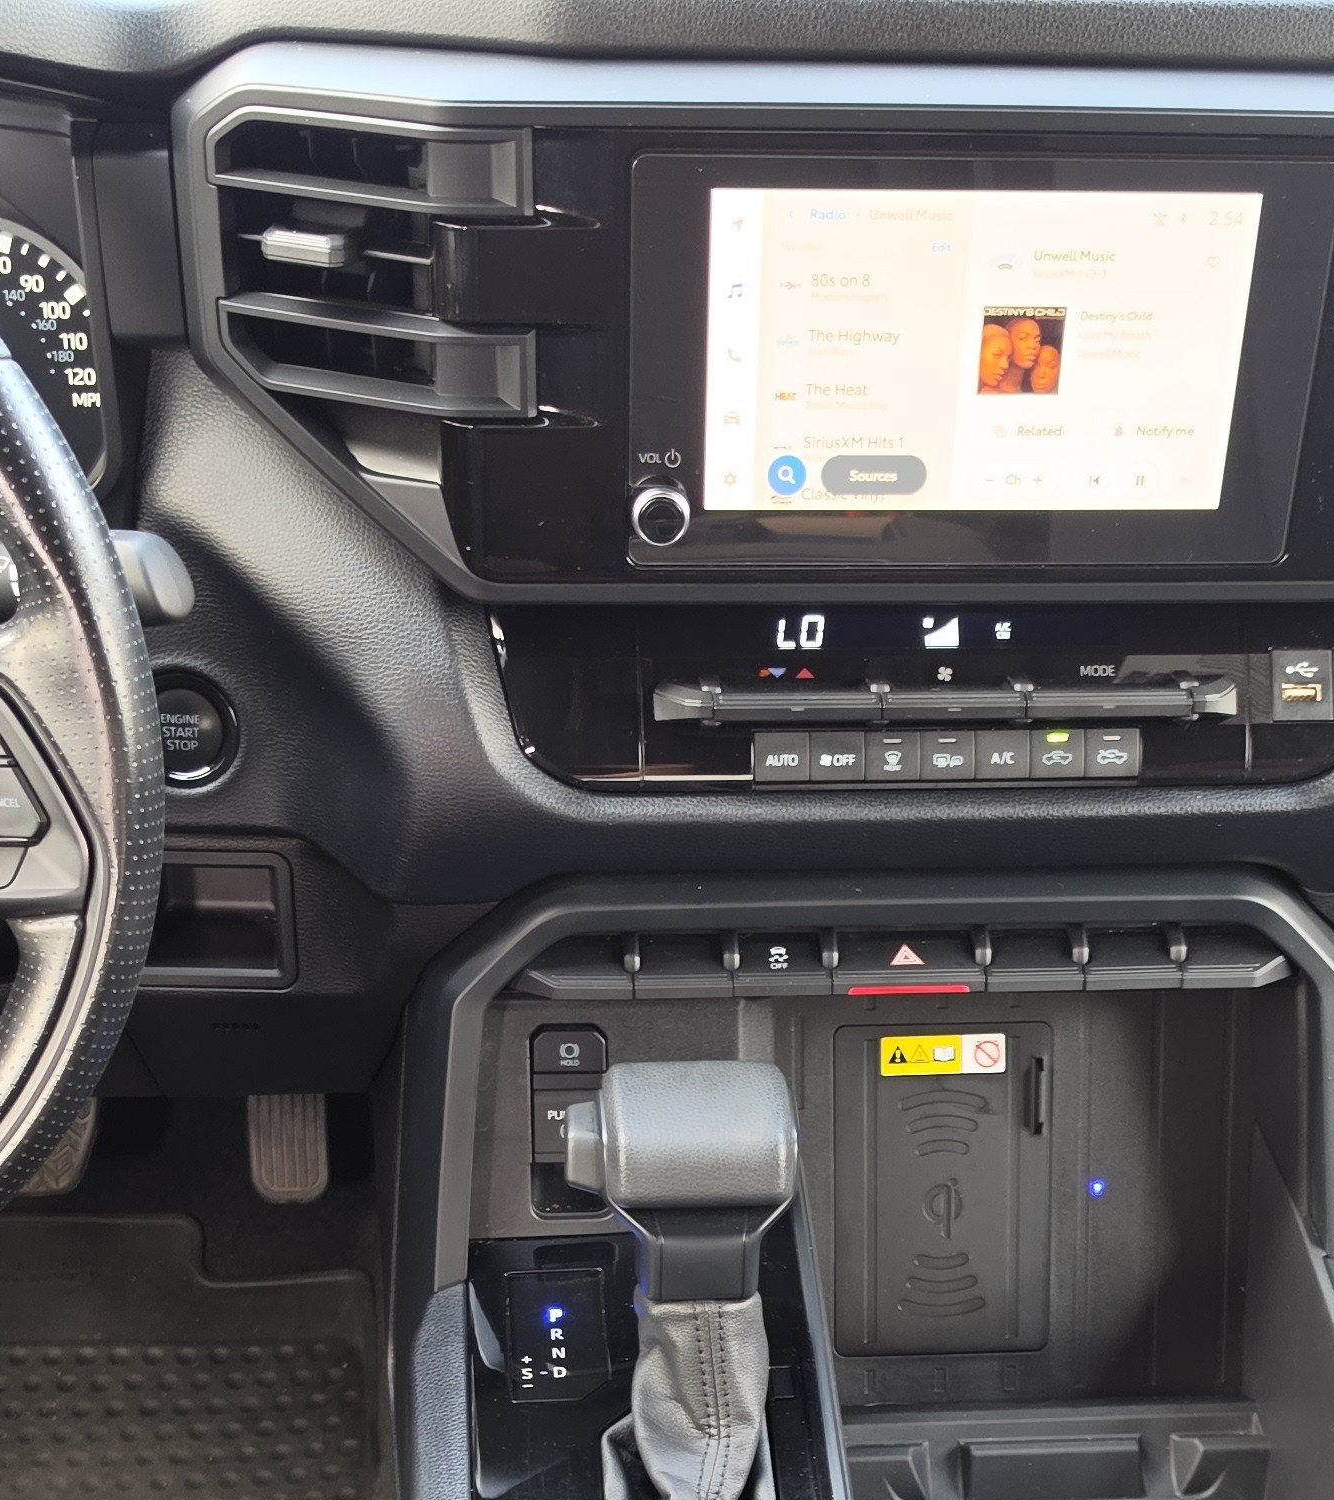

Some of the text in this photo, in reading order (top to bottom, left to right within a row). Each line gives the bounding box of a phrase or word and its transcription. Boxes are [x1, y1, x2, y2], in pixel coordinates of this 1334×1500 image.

[810, 208, 847, 220] Radio
[1033, 250, 1116, 262] Unwell Music
[19, 274, 45, 293] 90
[811, 273, 871, 288] 80s on 8
[2, 289, 26, 302] 140
[38, 301, 71, 320] 100
[1127, 311, 1153, 321] Child
[34, 319, 57, 332] 160
[58, 333, 88, 351] 110
[809, 329, 901, 346] The Highway
[51, 351, 75, 363] 180
[63, 367, 97, 386] 120
[806, 384, 869, 396] The Heat
[1017, 426, 1062, 437] Related
[1136, 426, 1195, 438] Notify me
[803, 436, 863, 449] SiriusXM
[867, 436, 894, 449] Hits
[638, 452, 662, 464] VOL
[849, 470, 898, 482] Sources
[776, 613, 826, 650] LO
[1080, 664, 1116, 677] MODE
[160, 713, 200, 725] ENGINE
[162, 726, 200, 738] START
[167, 739, 199, 751] STOP
[765, 754, 799, 767] AUTO
[832, 754, 856, 767] OFF
[990, 751, 1015, 765] A/C
[548, 1308, 564, 1322] P
[550, 1328, 565, 1341] R
[552, 1347, 566, 1360] N
[521, 1366, 567, 1380] S D
